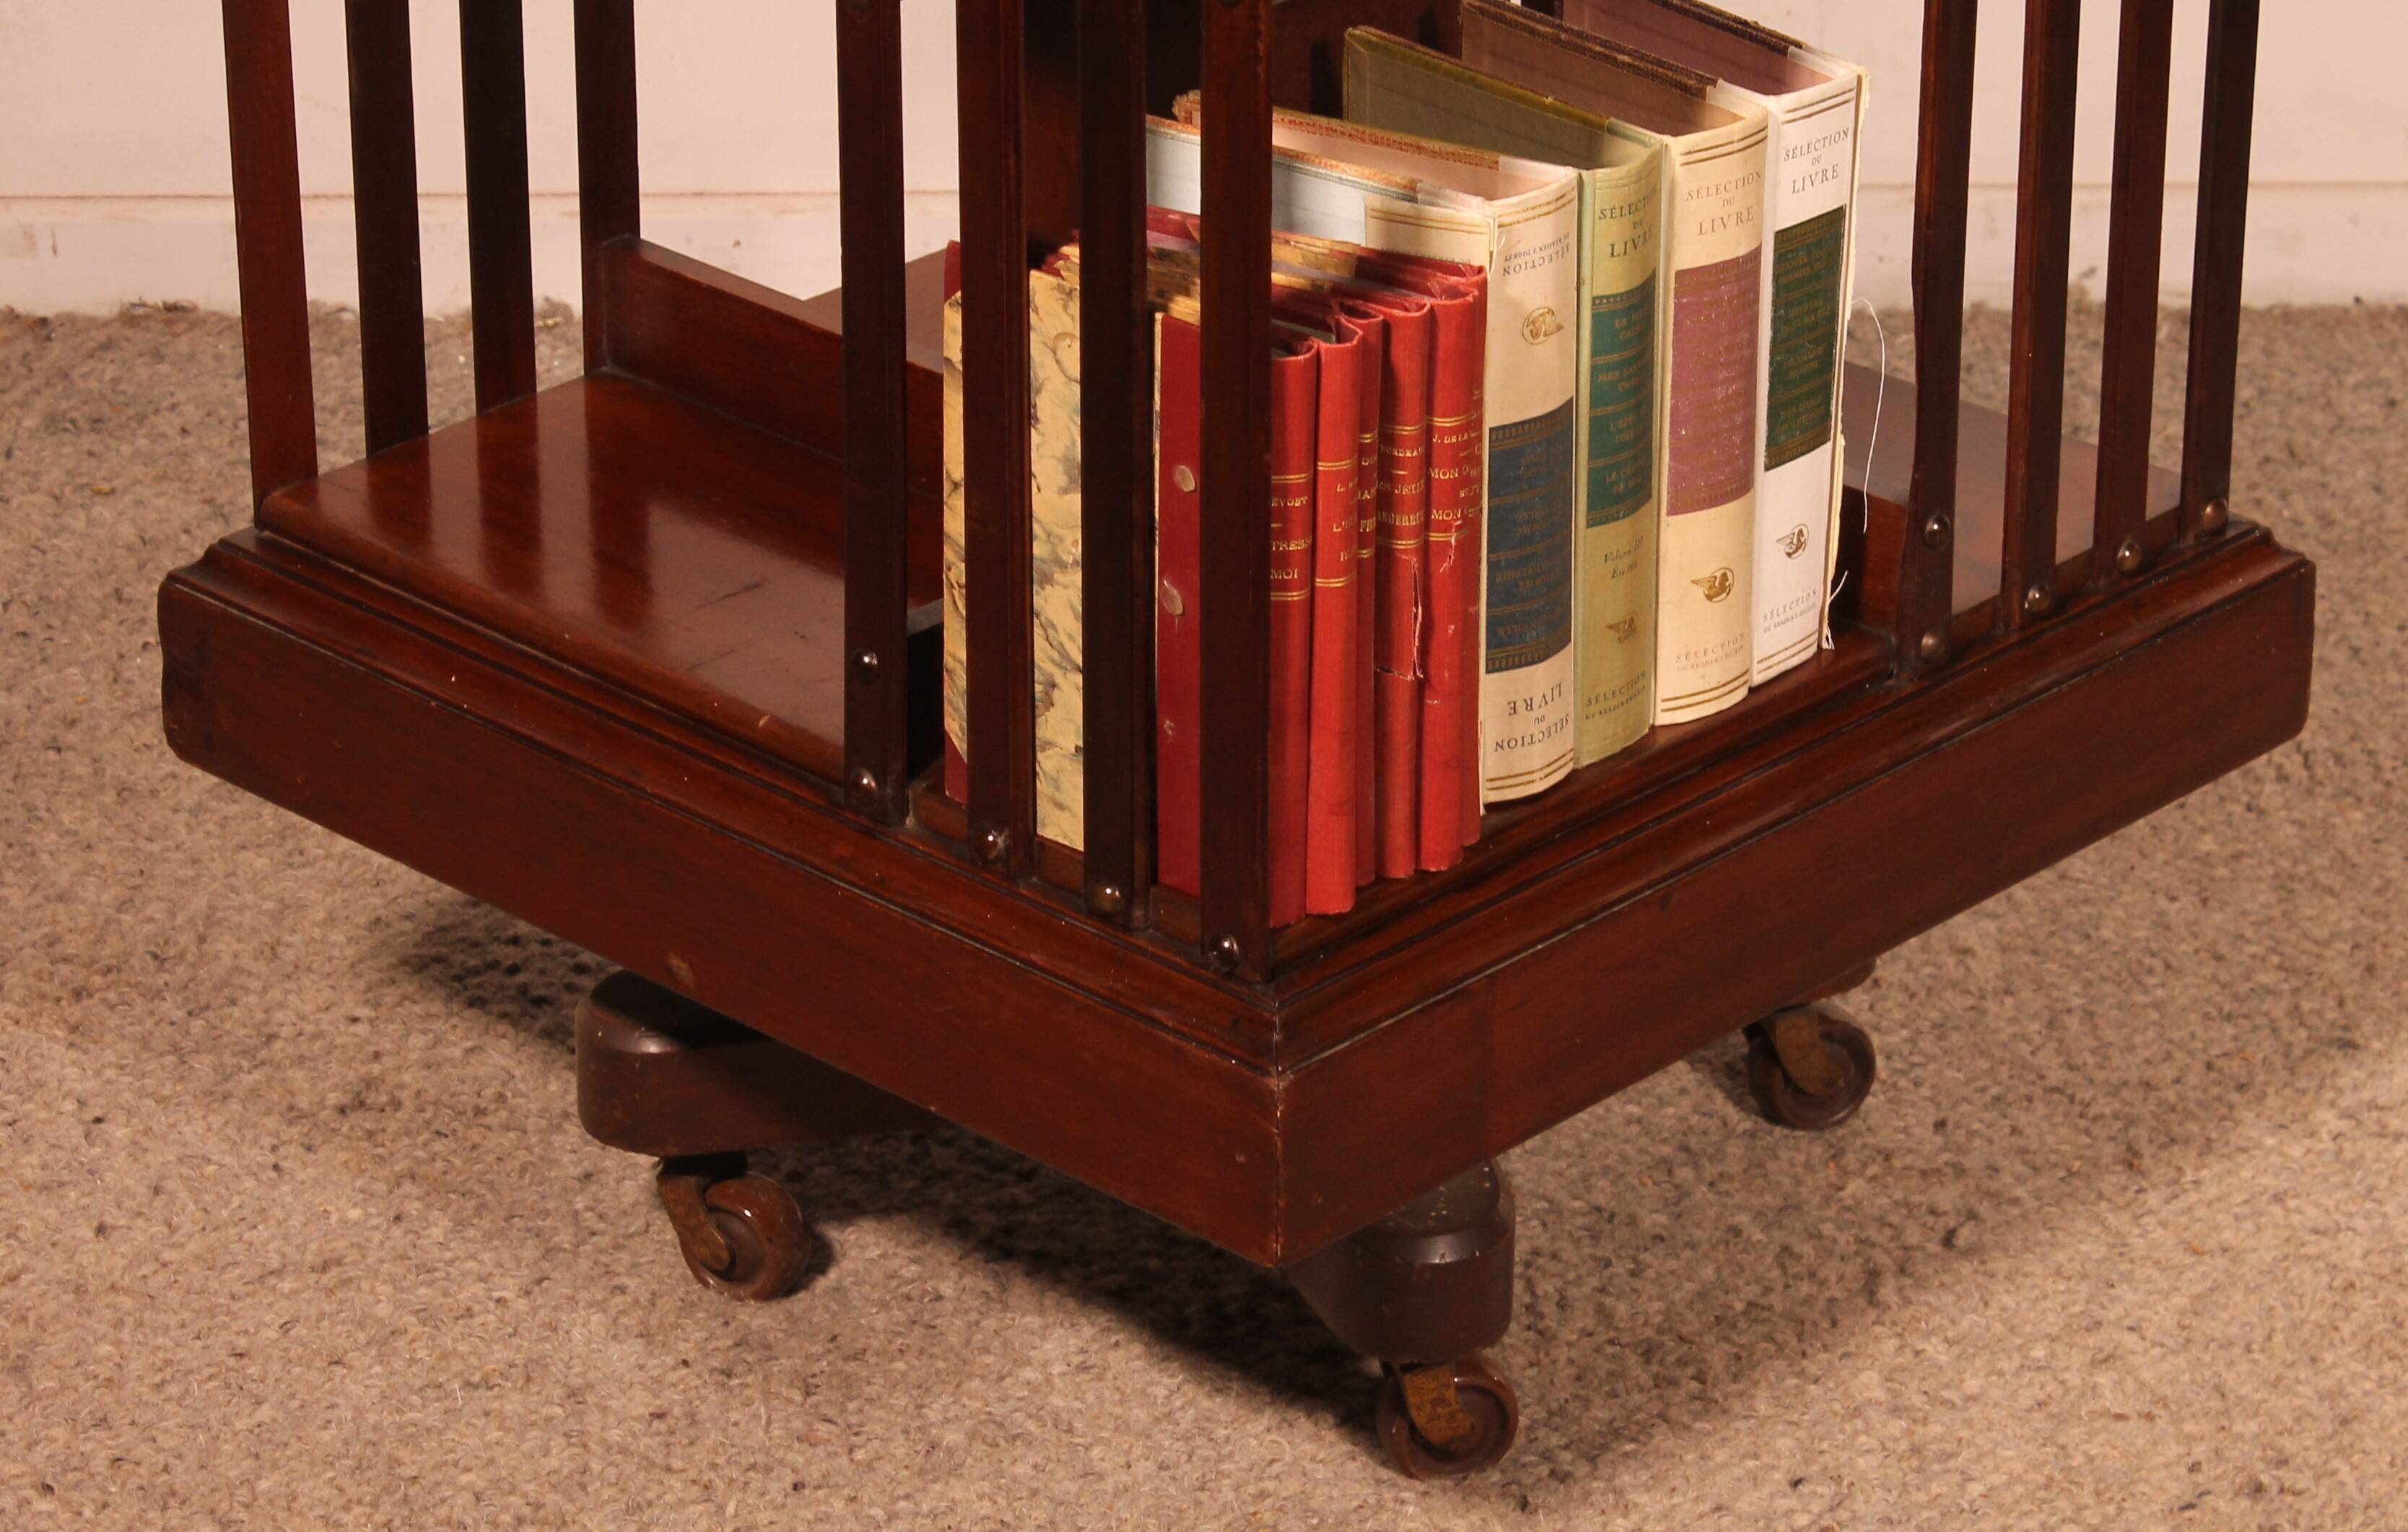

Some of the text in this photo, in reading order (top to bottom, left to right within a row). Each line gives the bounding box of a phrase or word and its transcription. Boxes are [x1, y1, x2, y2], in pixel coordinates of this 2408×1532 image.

[1783, 127, 1849, 162] SÉLECTION
[1811, 154, 1822, 166] DU
[1686, 169, 1761, 201] SÉLECTION
[1791, 163, 1838, 194] LIVRE
[1722, 197, 1735, 207] DU
[1698, 205, 1754, 235] LIVRE
[1609, 222, 1653, 258] LIVRE
[1430, 467, 1459, 479] MON
[1270, 495, 1309, 507] EVOST
[1431, 508, 1462, 521] MON
[1270, 568, 1299, 580] MOI
[1507, 682, 1562, 716] LIVRE
[1534, 715, 1545, 725] DU
[1494, 713, 1569, 752] SÉLECTION
